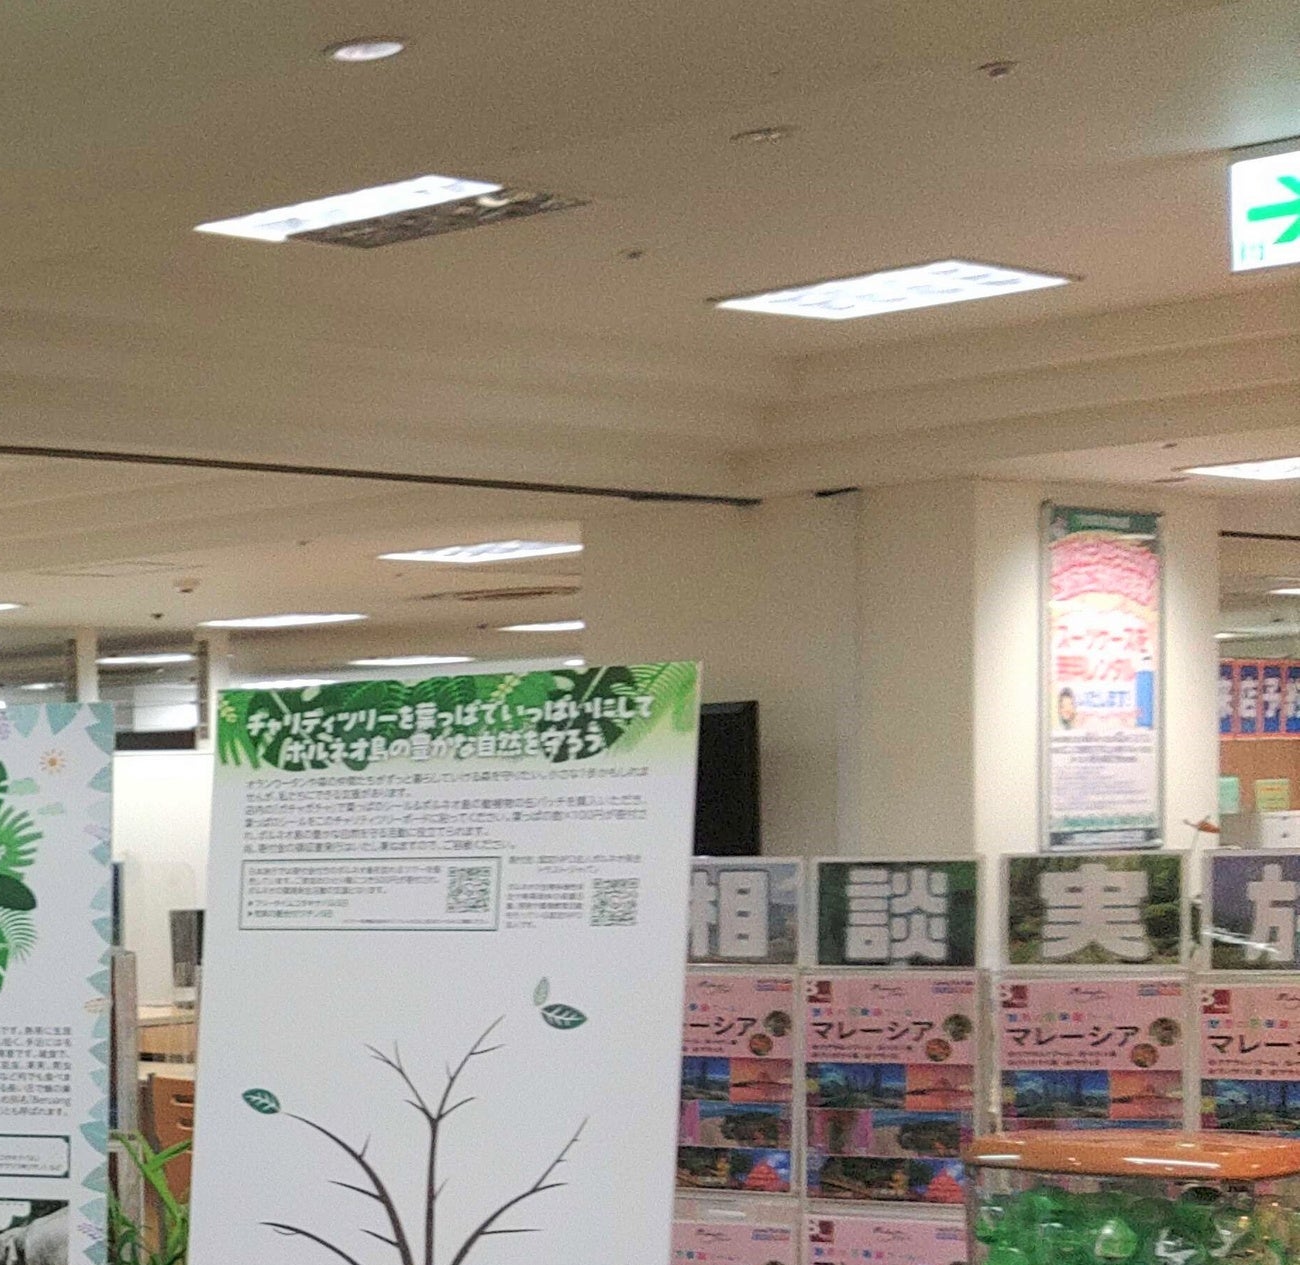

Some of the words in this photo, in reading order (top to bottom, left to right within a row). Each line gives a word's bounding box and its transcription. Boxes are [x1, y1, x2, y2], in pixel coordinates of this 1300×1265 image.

[843, 866, 949, 962] 談
[1038, 862, 1153, 962] 実
[687, 1016, 758, 1037] ーシア
[811, 1020, 935, 1042] マレーシア
[1005, 1024, 1141, 1047] マレーシア
[1207, 1034, 1300, 1056] マレー
